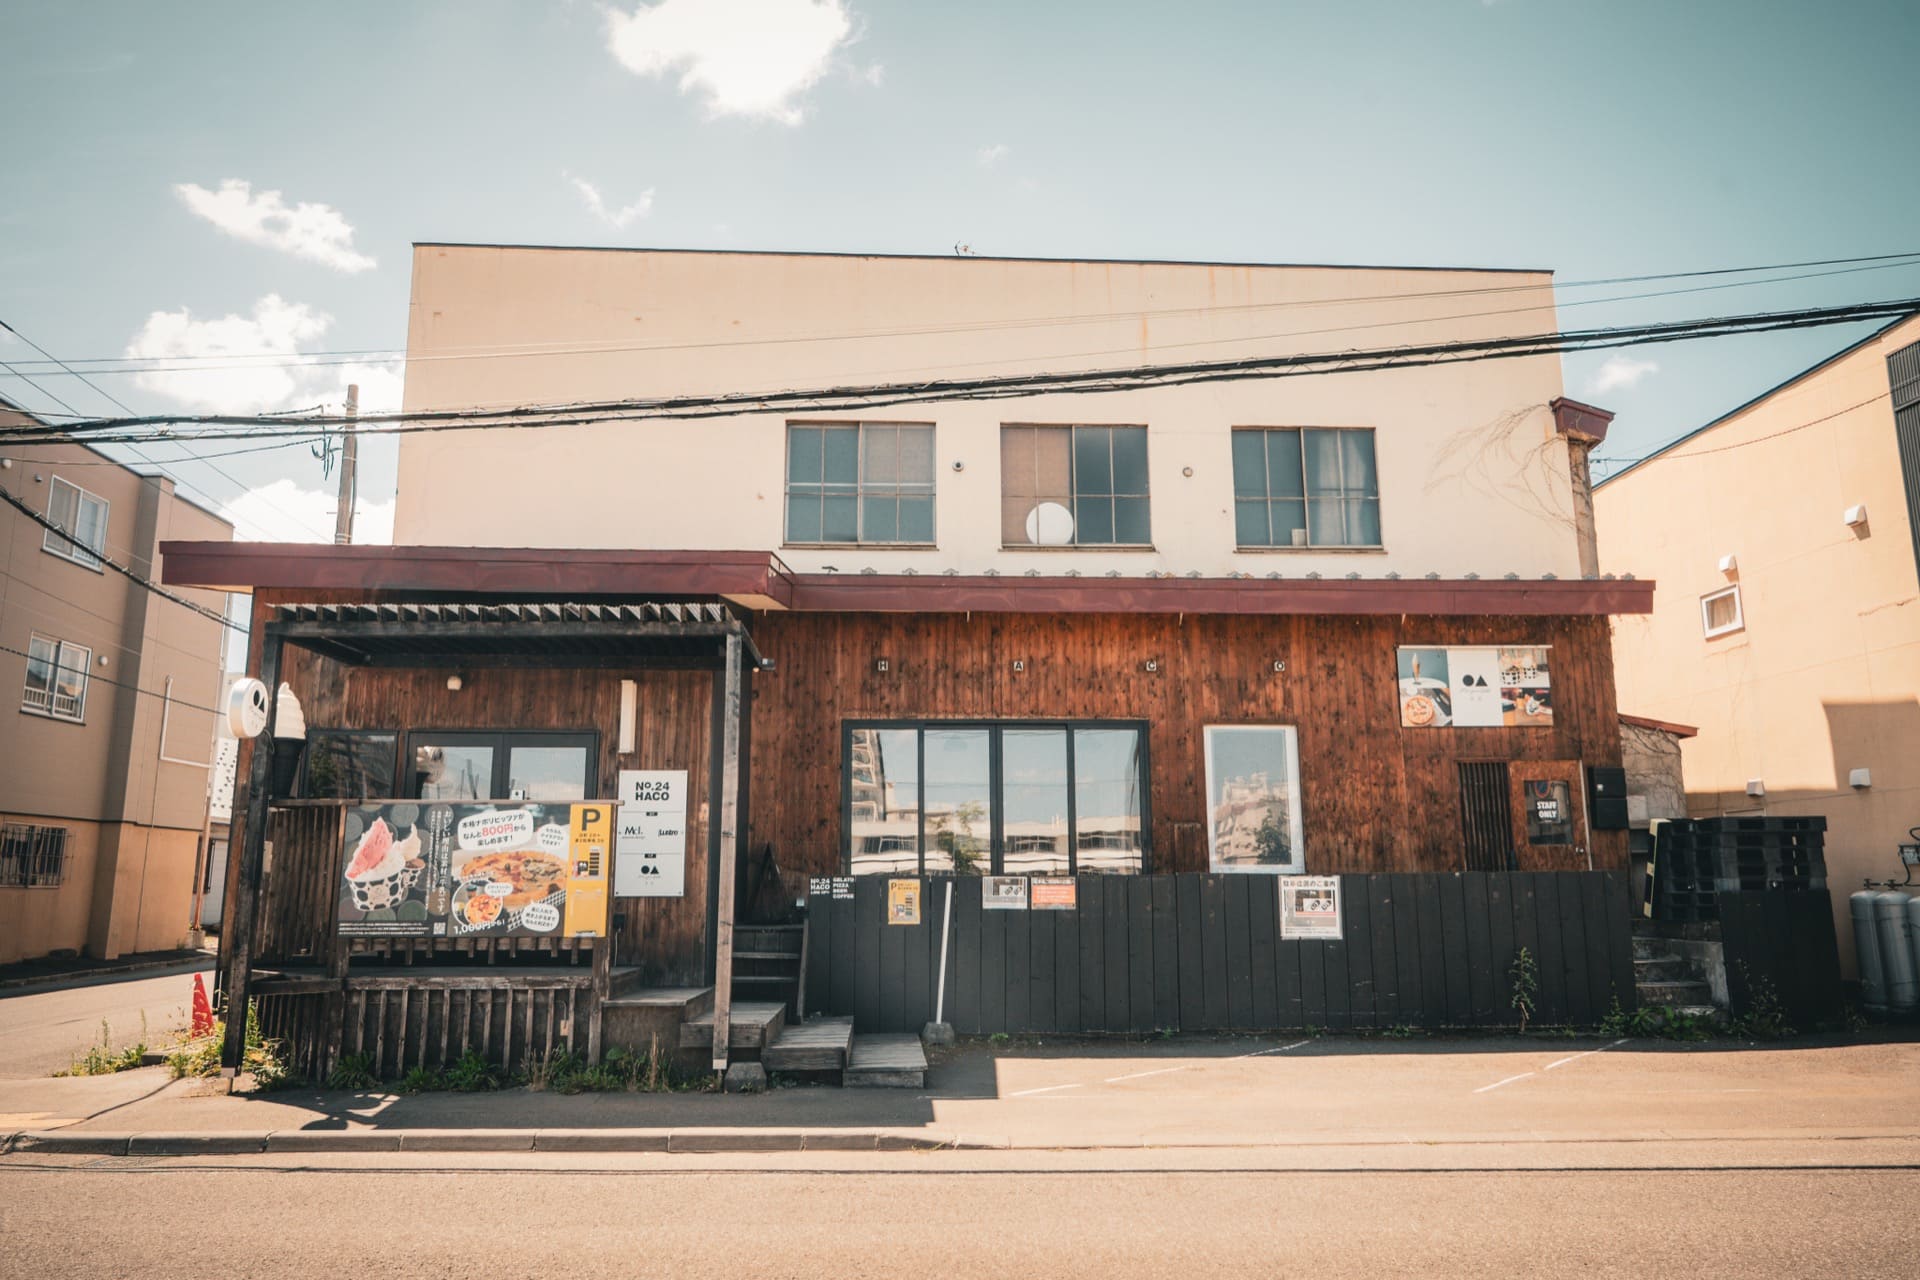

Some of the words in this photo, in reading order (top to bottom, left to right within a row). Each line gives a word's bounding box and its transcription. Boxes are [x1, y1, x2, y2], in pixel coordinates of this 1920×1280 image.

[635, 791, 670, 801] HACO
[1537, 801, 1556, 809] STAFF
[581, 808, 601, 831] P
